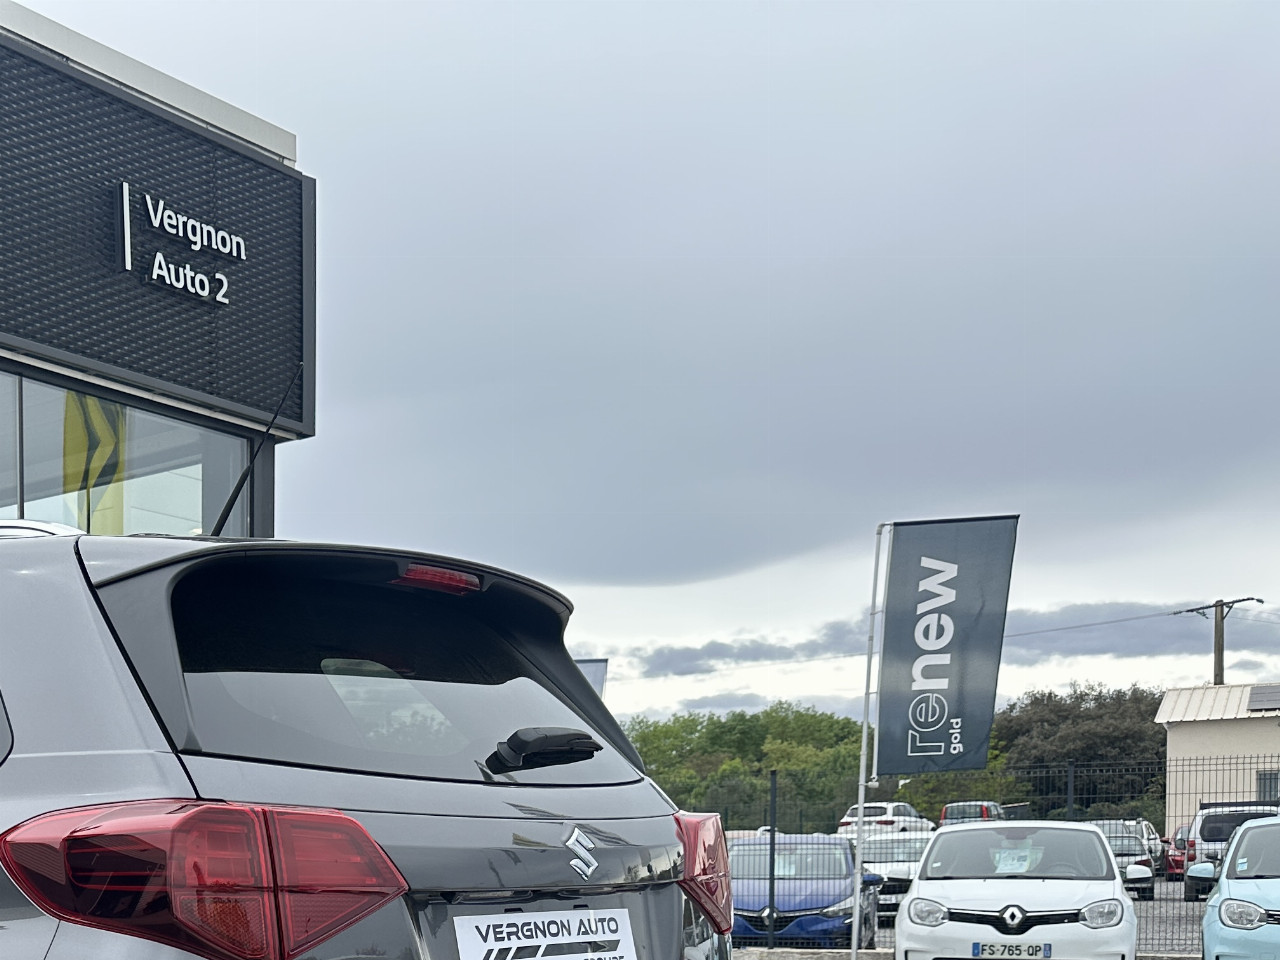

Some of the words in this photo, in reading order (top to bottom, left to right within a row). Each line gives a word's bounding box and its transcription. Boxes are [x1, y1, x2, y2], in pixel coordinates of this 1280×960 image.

[145, 194, 247, 260] Vergnon
[152, 251, 210, 297] Auto
[215, 272, 230, 304] 2
[907, 556, 959, 757] renew
[948, 717, 964, 755] gold
[474, 919, 572, 944] VERGNON
[577, 917, 619, 936] AUTO
[980, 944, 1042, 957] FS-765-QP
